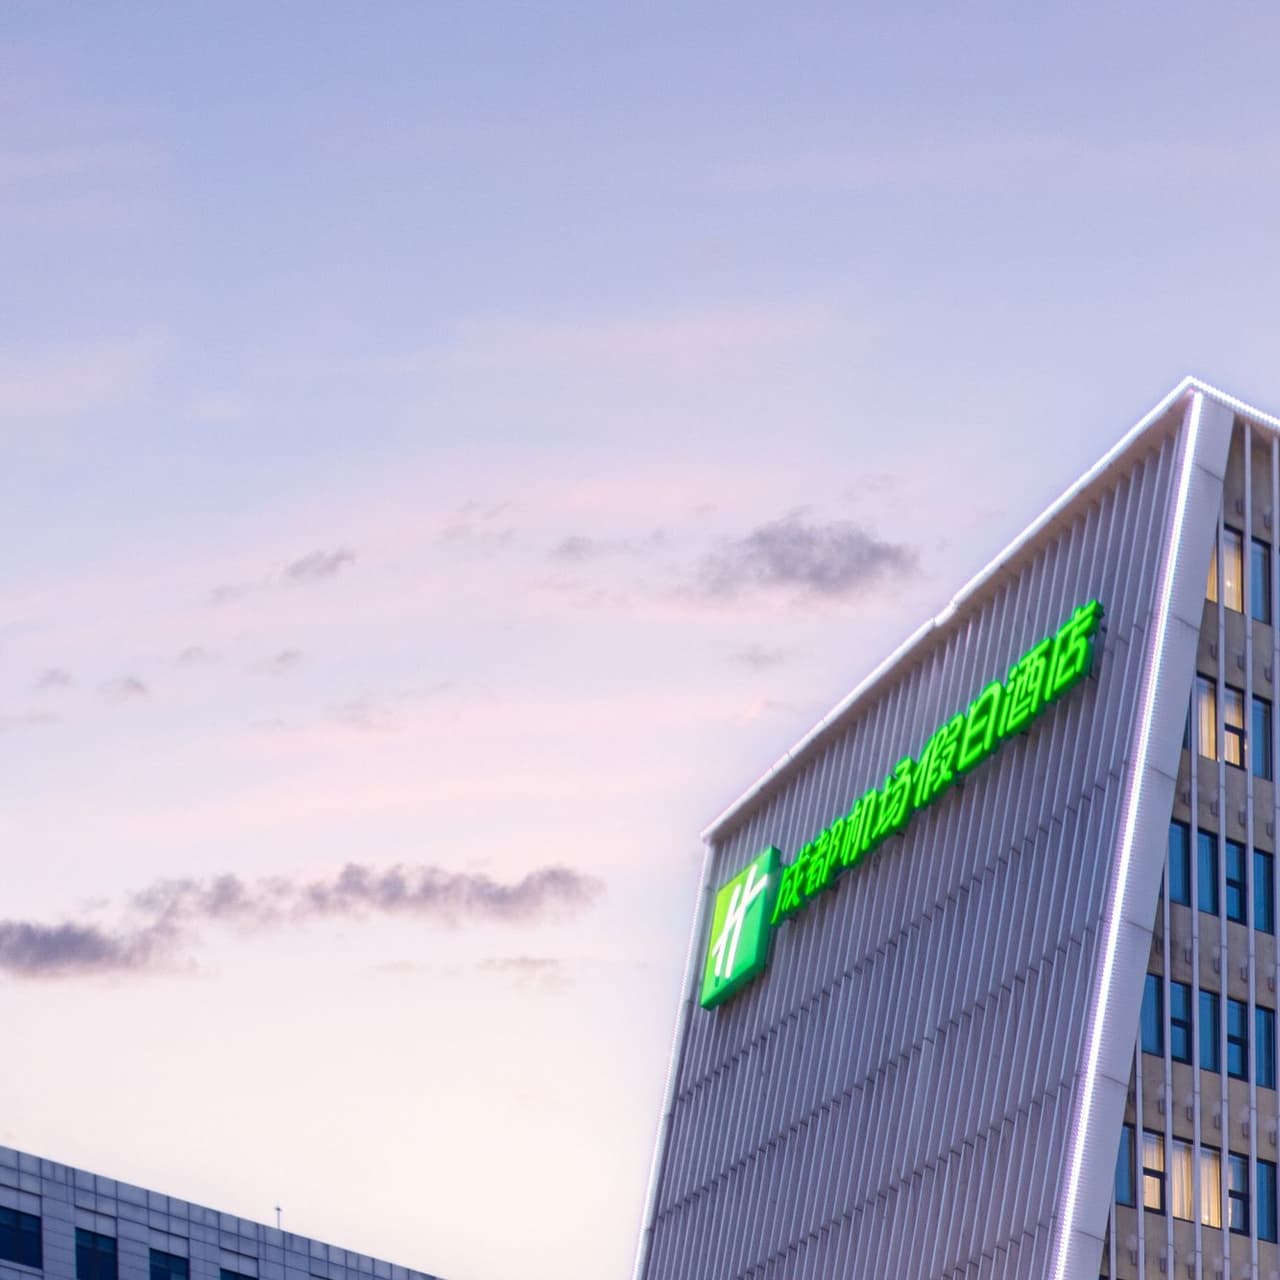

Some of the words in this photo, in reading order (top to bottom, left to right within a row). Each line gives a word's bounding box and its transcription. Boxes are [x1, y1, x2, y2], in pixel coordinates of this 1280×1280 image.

[770, 599, 1103, 926] 成都机场假日酒店
